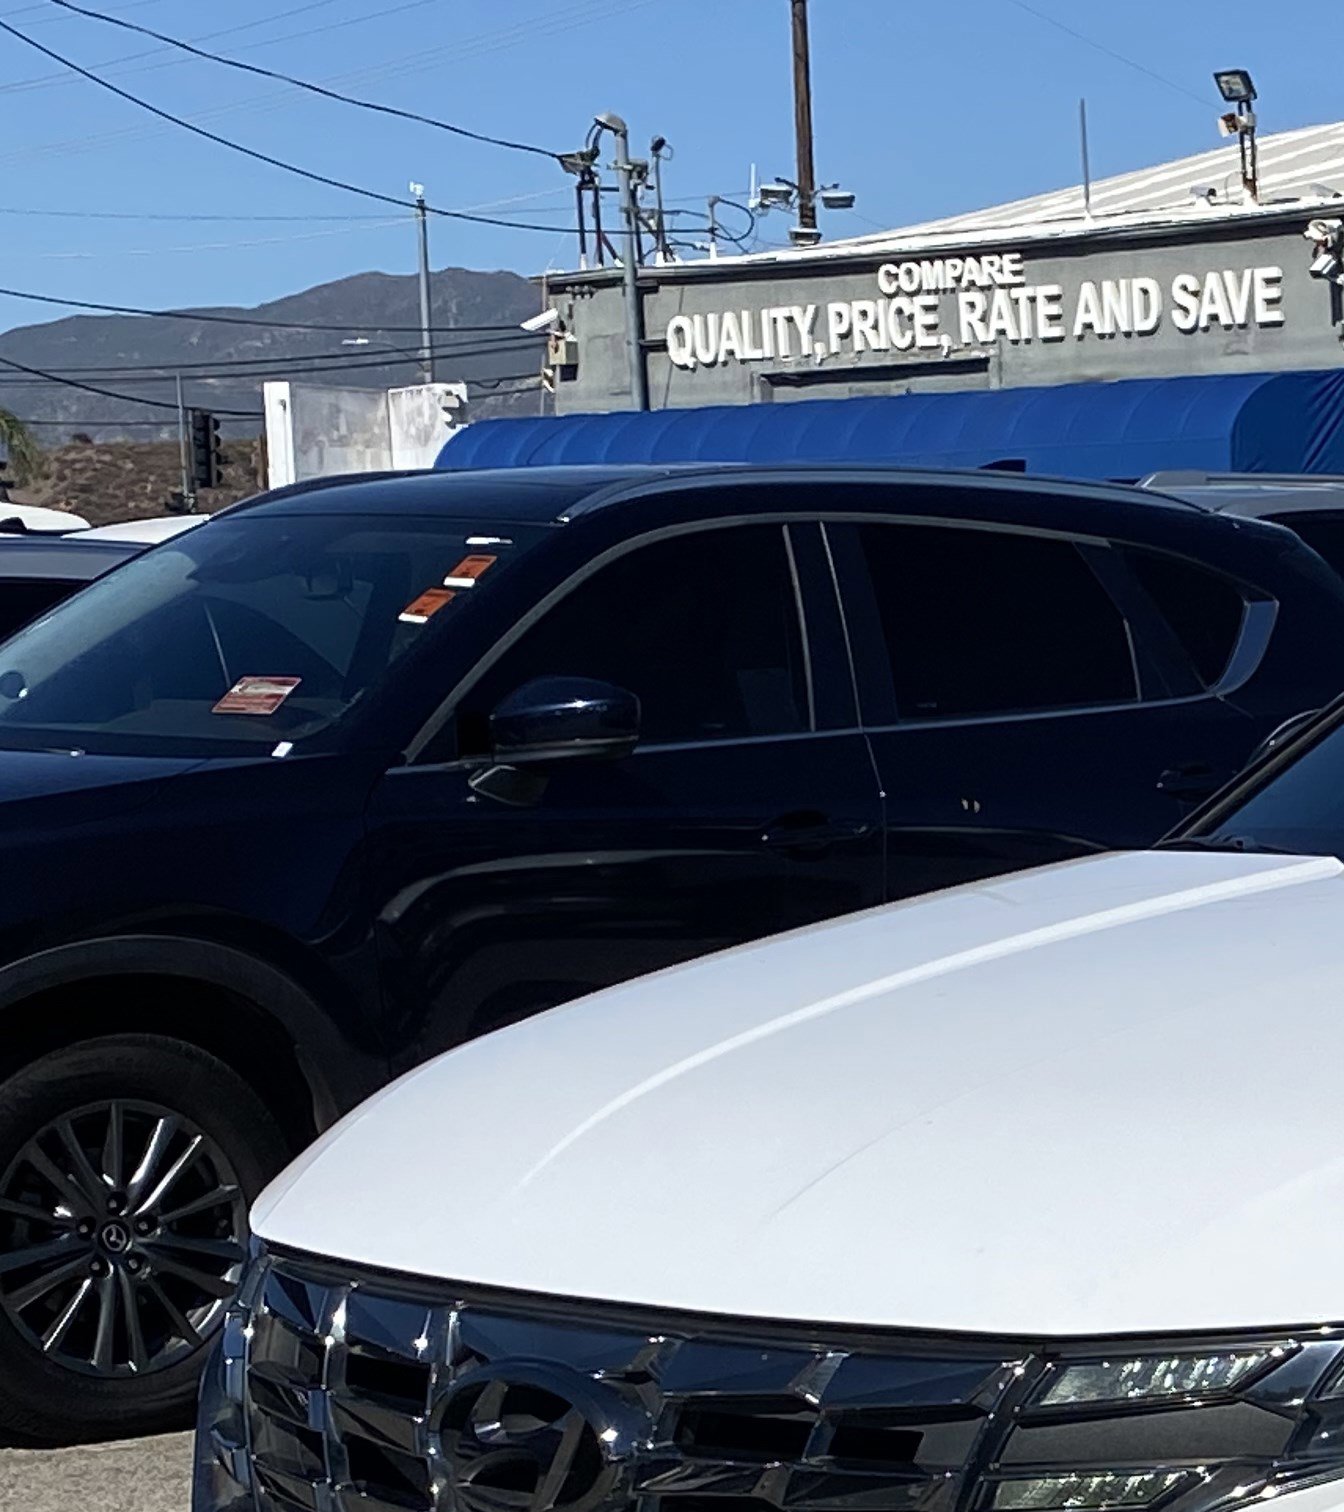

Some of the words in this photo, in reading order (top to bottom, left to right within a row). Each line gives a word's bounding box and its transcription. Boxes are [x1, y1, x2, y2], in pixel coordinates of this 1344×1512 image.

[877, 253, 1026, 295] COMPARE
[666, 303, 826, 369] QUALITY,
[827, 294, 951, 358] PRICE,
[958, 284, 1065, 344] RATE
[1073, 277, 1163, 339] AND
[1171, 266, 1286, 333] SAVE
